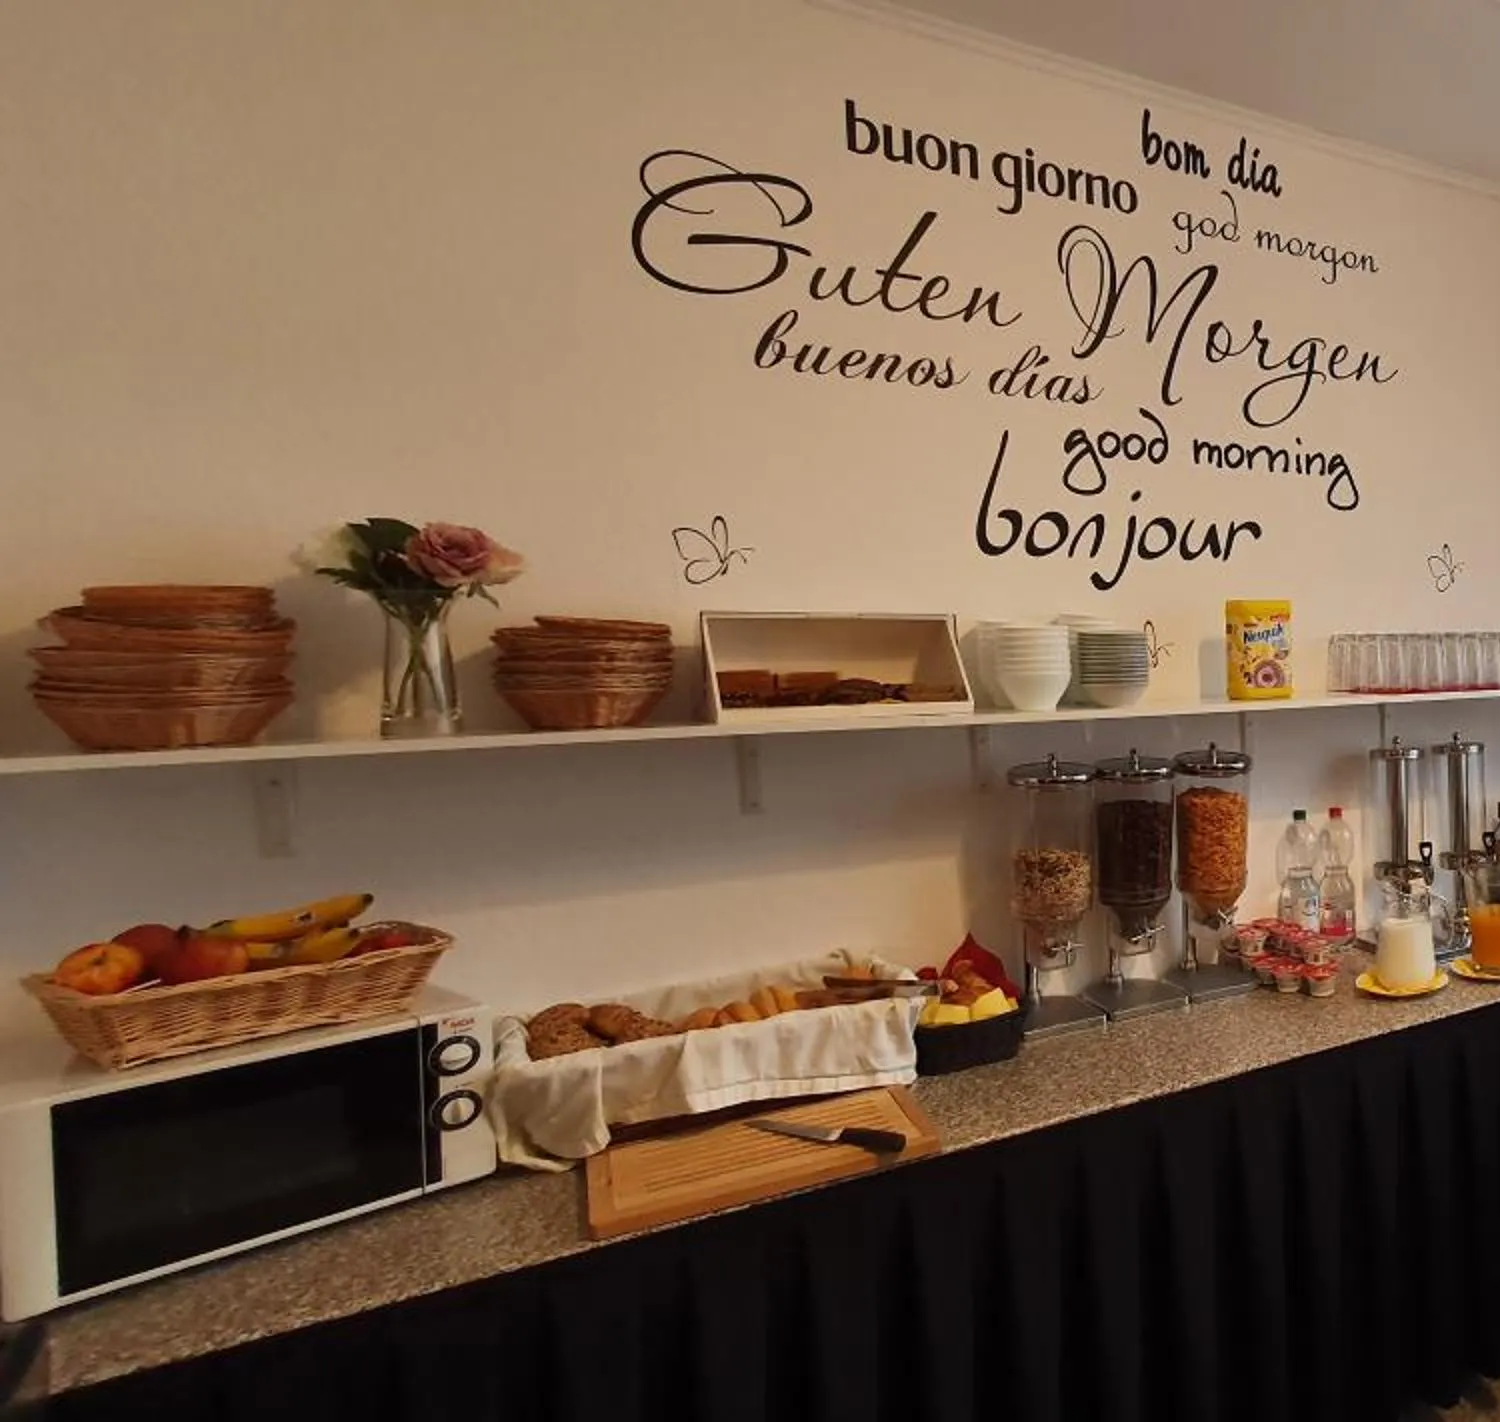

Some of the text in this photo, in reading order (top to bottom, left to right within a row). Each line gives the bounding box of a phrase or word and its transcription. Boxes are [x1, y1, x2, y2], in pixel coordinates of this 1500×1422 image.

[845, 98, 1138, 215] buon giorno
[1142, 108, 1282, 198] bom dia
[631, 150, 1398, 428] Guten Morgen
[1172, 190, 1379, 285] god morgon
[753, 309, 971, 389] buenos
[976, 430, 1263, 591] bonjour
[1062, 407, 1360, 511] good morning
